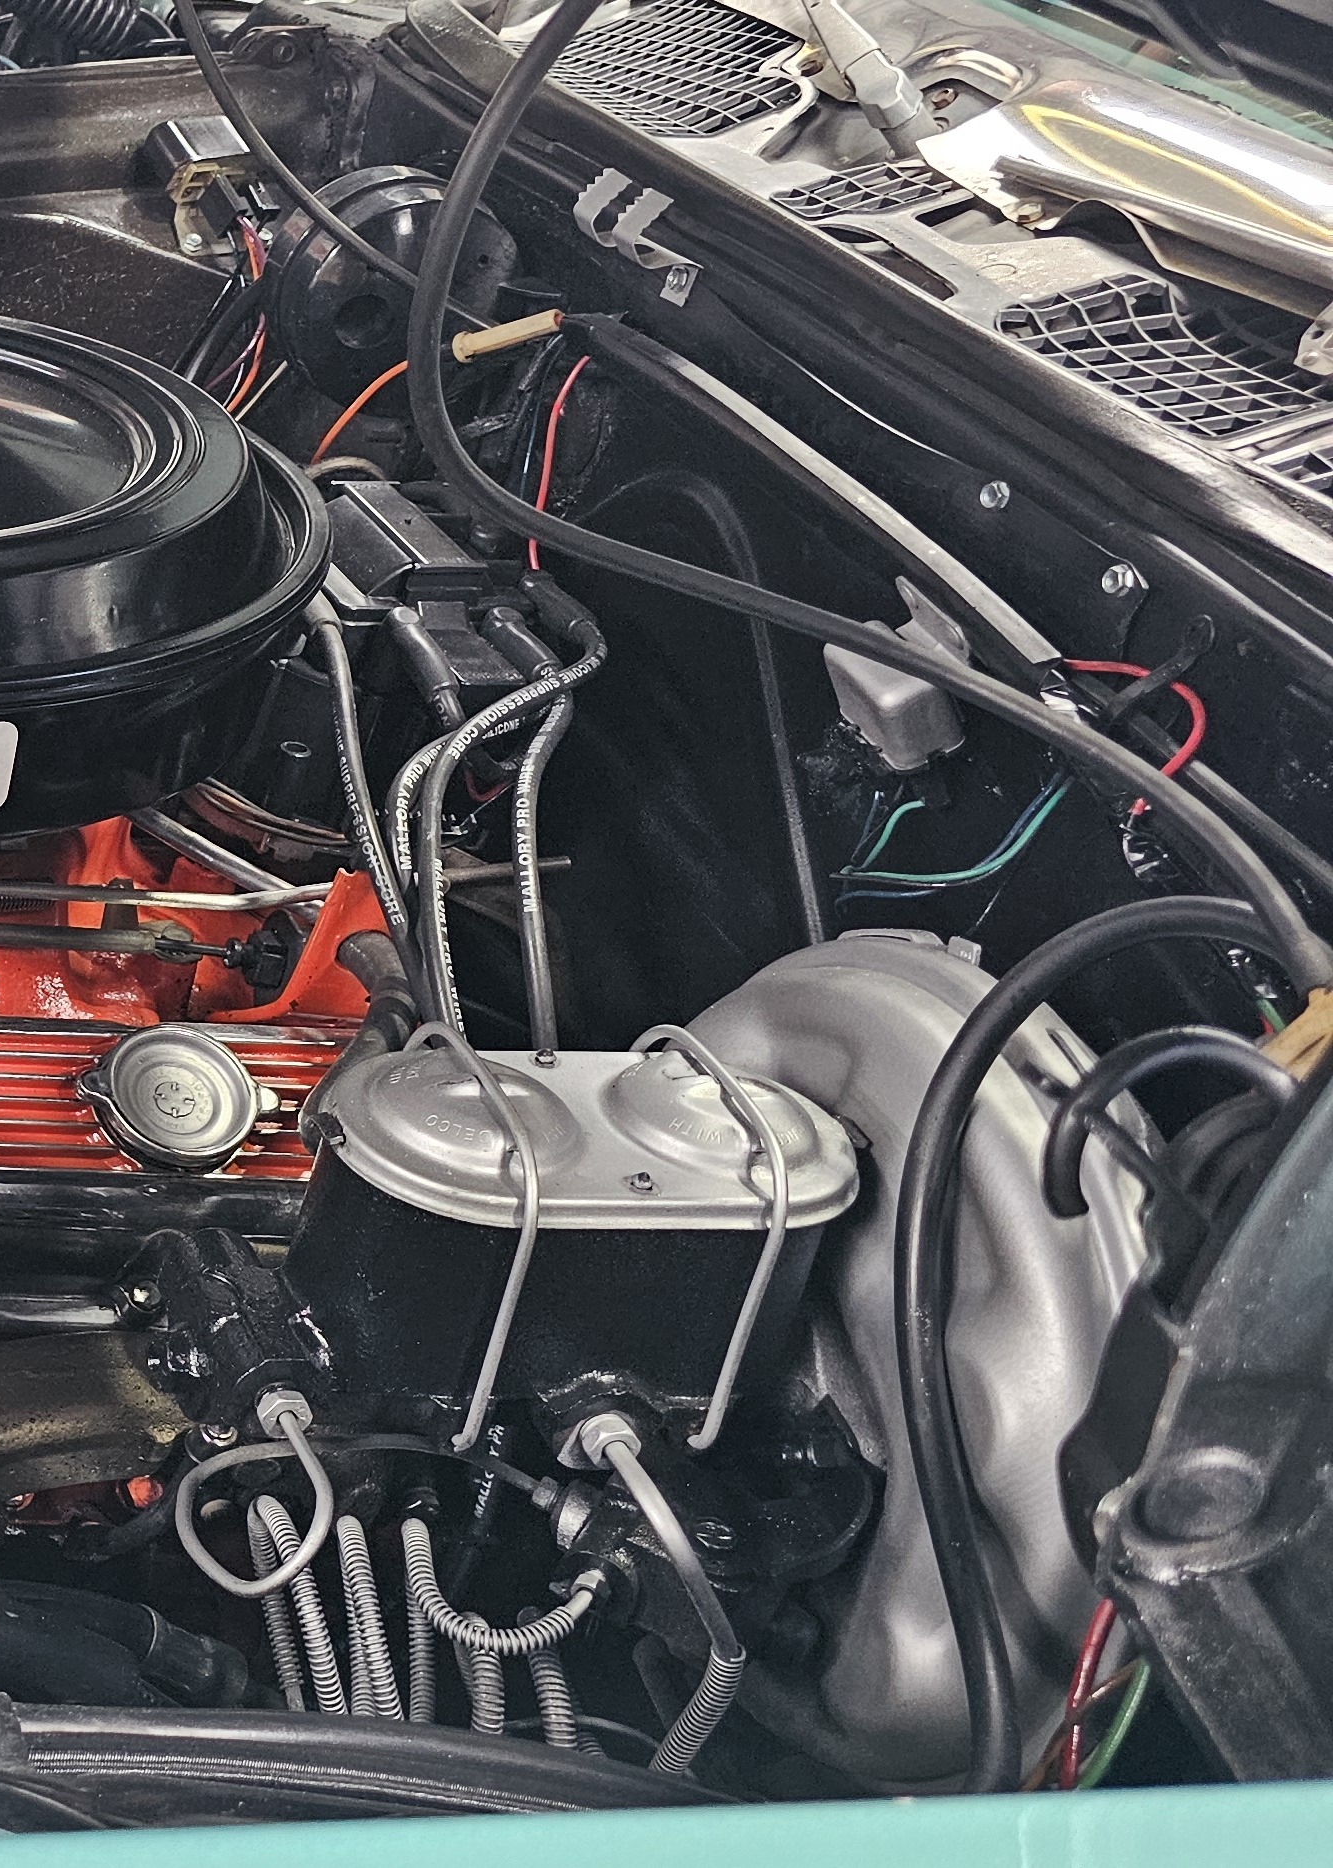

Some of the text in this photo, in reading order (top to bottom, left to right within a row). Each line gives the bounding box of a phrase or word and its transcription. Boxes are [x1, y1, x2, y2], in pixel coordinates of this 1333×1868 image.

[477, 677, 561, 730] SUPPRESSION
[448, 726, 480, 761] CORE
[396, 785, 413, 870] MALLORY
[405, 764, 425, 789] PRO
[516, 798, 531, 827] PRO
[516, 832, 539, 913] MALLORY
[668, 1117, 722, 1144] WITH
